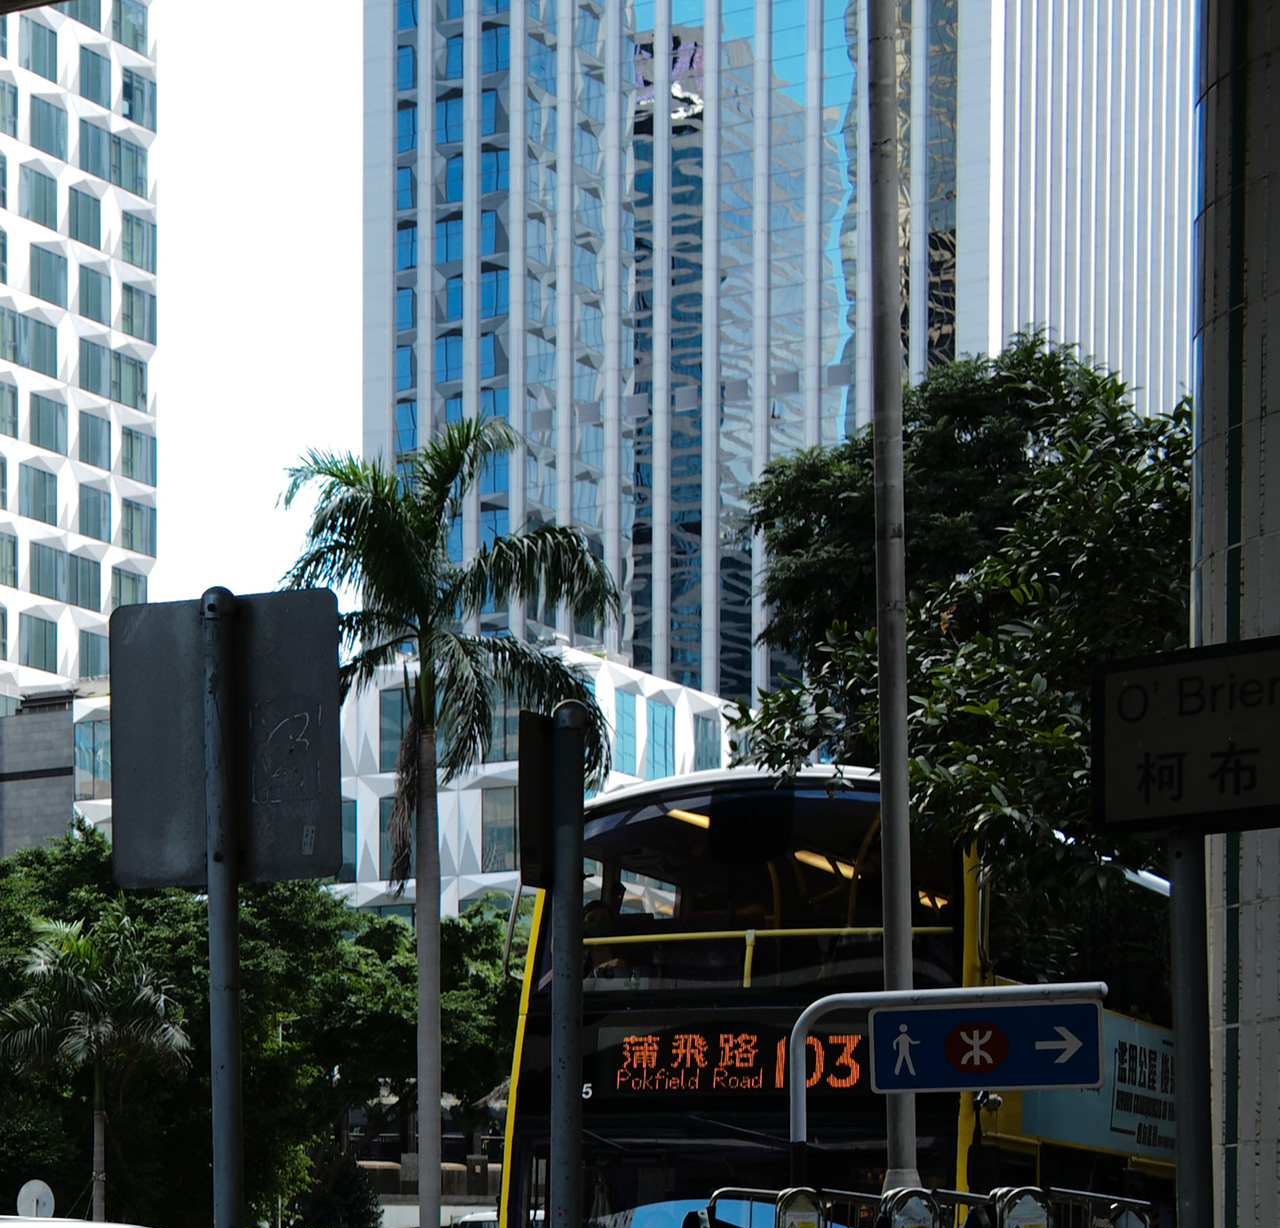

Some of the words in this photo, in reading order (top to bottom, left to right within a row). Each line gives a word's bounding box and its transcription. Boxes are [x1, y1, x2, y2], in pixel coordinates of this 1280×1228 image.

[1117, 680, 1159, 723] O'
[1136, 742, 1260, 805] 柯布
[622, 1033, 759, 1069] 蒲飛路
[775, 1034, 862, 1089] 103
[617, 1067, 700, 1091] Pokfield
[712, 1067, 763, 1090] Road
